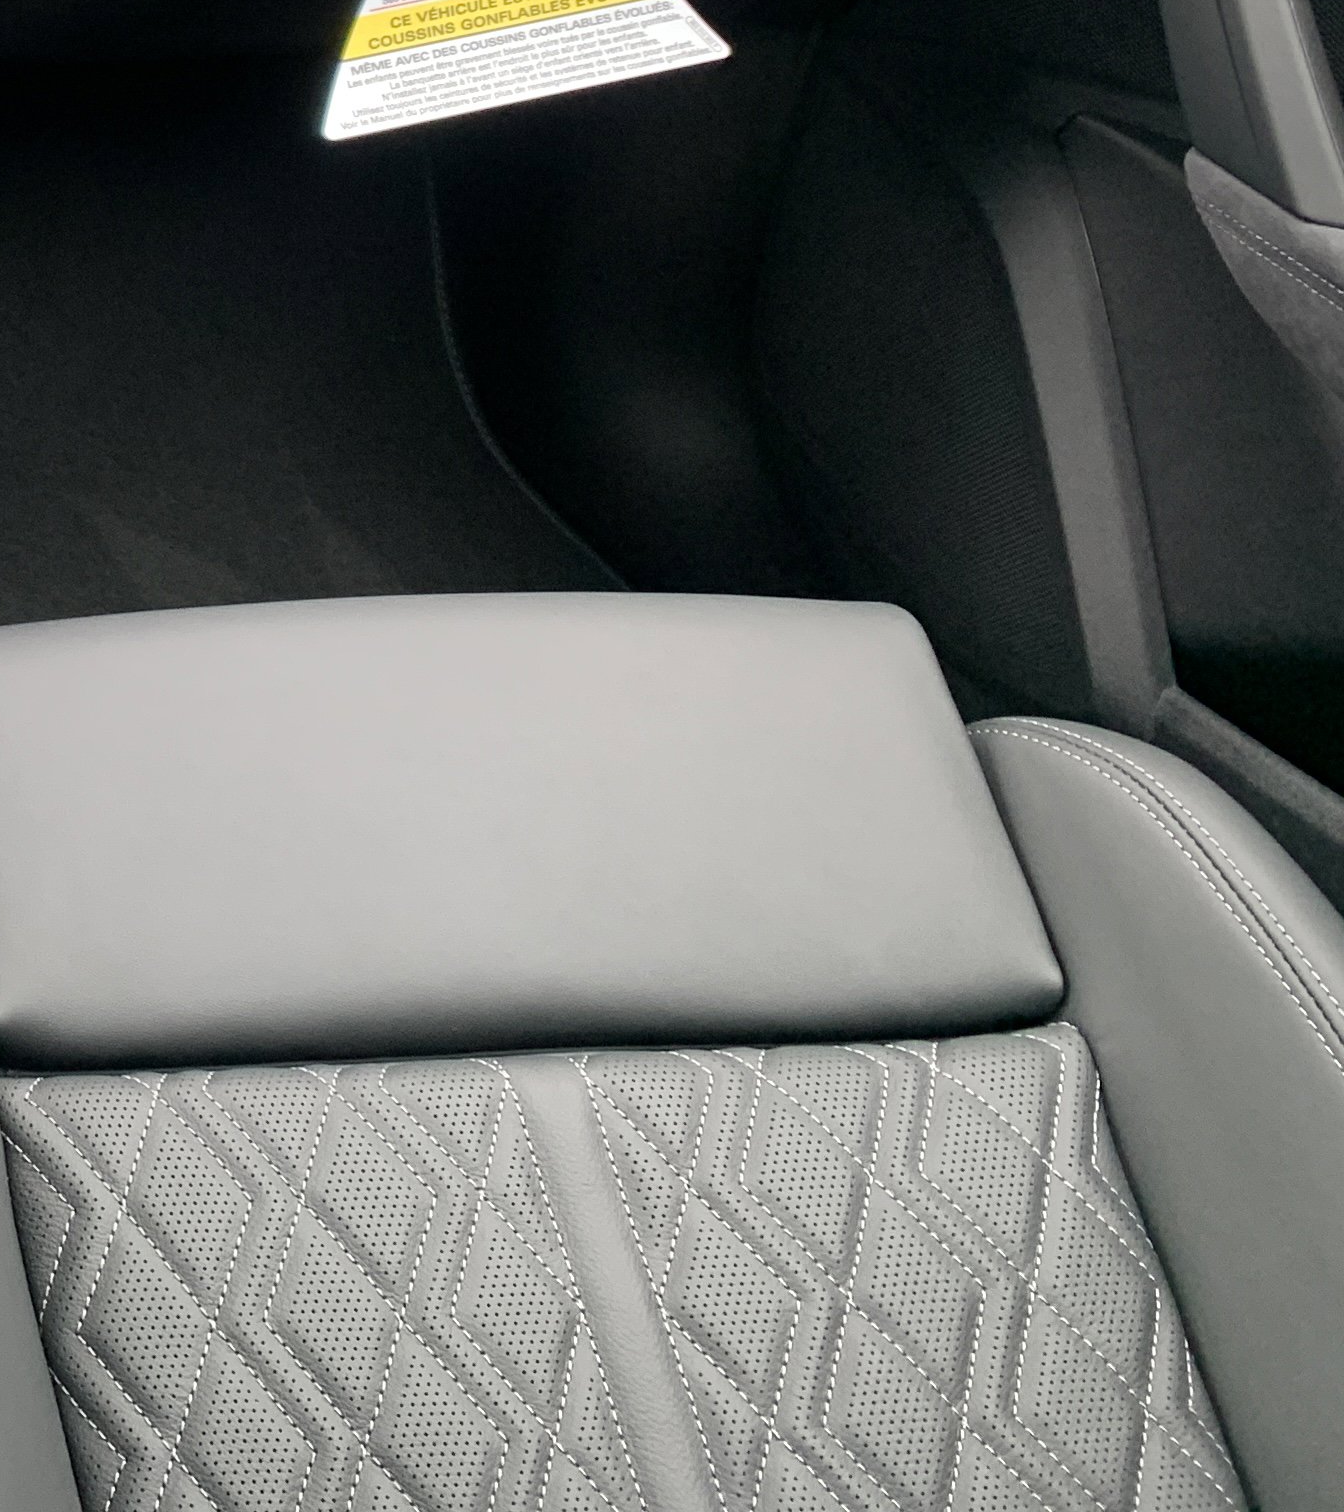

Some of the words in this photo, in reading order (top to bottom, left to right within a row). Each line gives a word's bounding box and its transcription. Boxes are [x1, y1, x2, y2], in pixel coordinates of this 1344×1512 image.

[368, 21, 454, 50] COUSSINS
[389, 13, 411, 29] CE
[350, 56, 391, 75] MÊME
[394, 50, 430, 66] AVEC
[432, 44, 457, 58] DES
[460, 30, 525, 52] COUSSINS
[529, 12, 611, 38] GONFLABLES
